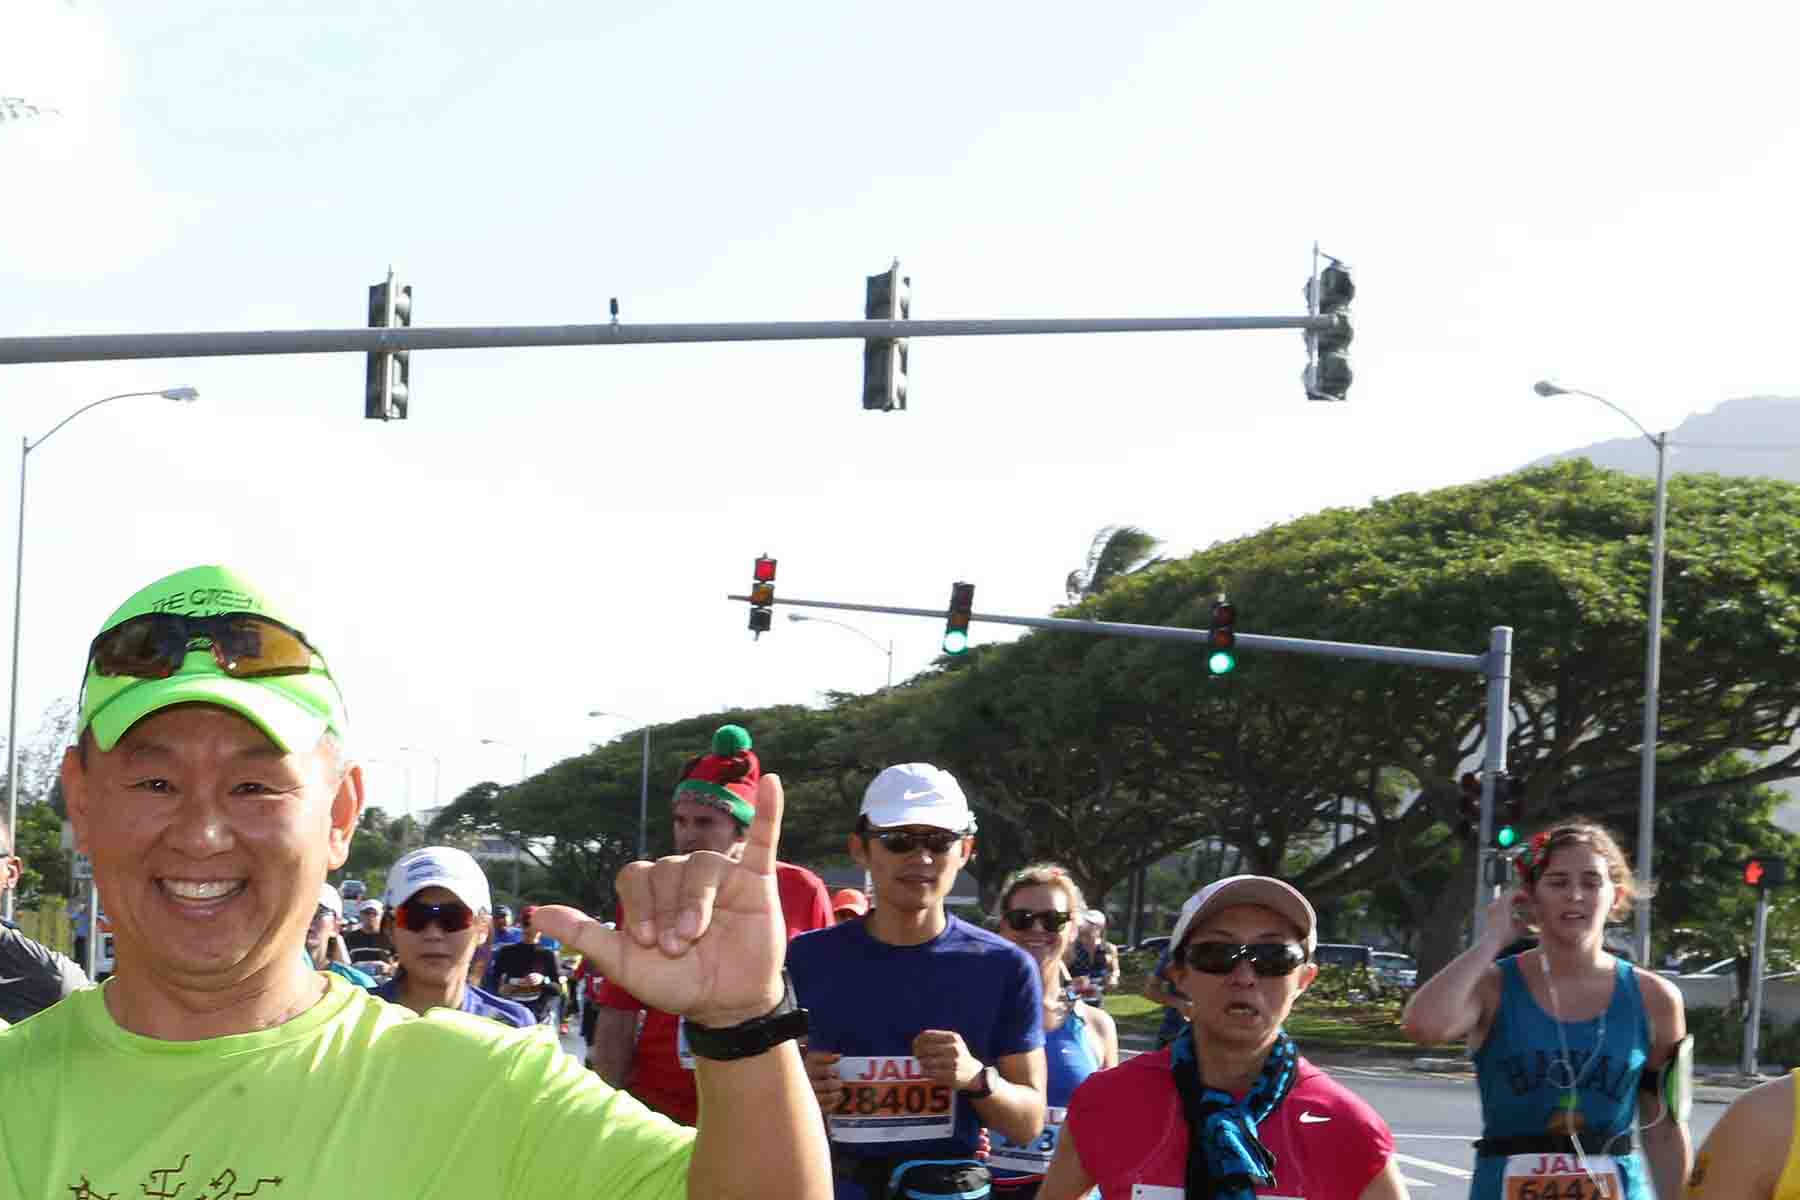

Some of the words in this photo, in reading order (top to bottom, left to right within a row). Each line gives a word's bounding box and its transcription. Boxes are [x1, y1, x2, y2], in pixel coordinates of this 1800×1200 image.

[861, 1059, 922, 1080] JAL
[834, 1085, 950, 1114] 28405
[1531, 1155, 1588, 1175] JAL
